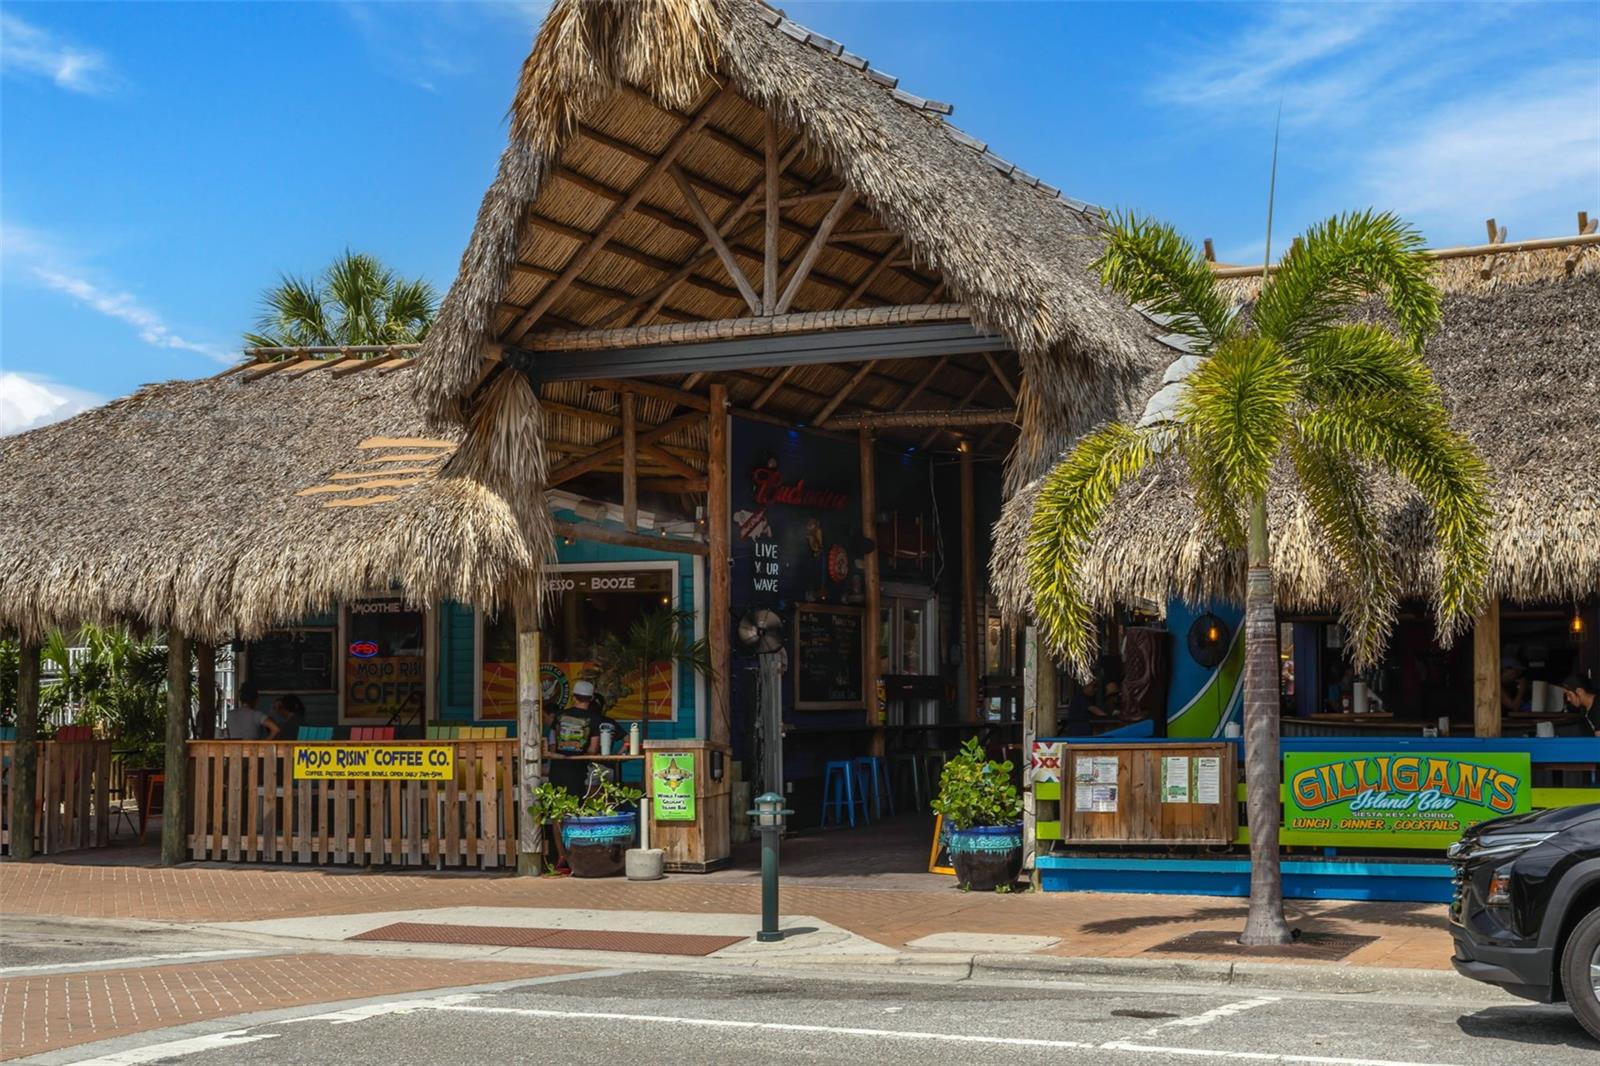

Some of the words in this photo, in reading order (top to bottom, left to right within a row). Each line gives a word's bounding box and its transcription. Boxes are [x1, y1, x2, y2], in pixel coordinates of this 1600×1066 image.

[755, 543, 778, 559] LIVE
[591, 577, 635, 590] BOOZE
[754, 579, 778, 592] WAVE
[374, 750, 423, 766] COFFEE
[428, 750, 449, 766] CO.
[1292, 757, 1520, 813] GILLIGAN'S
[1350, 790, 1416, 811] Island
[1417, 789, 1457, 811] Bar
[1292, 818, 1331, 829] LUNCH
[1340, 818, 1385, 830] DINNER
[1394, 819, 1460, 831] COCKTAILS
